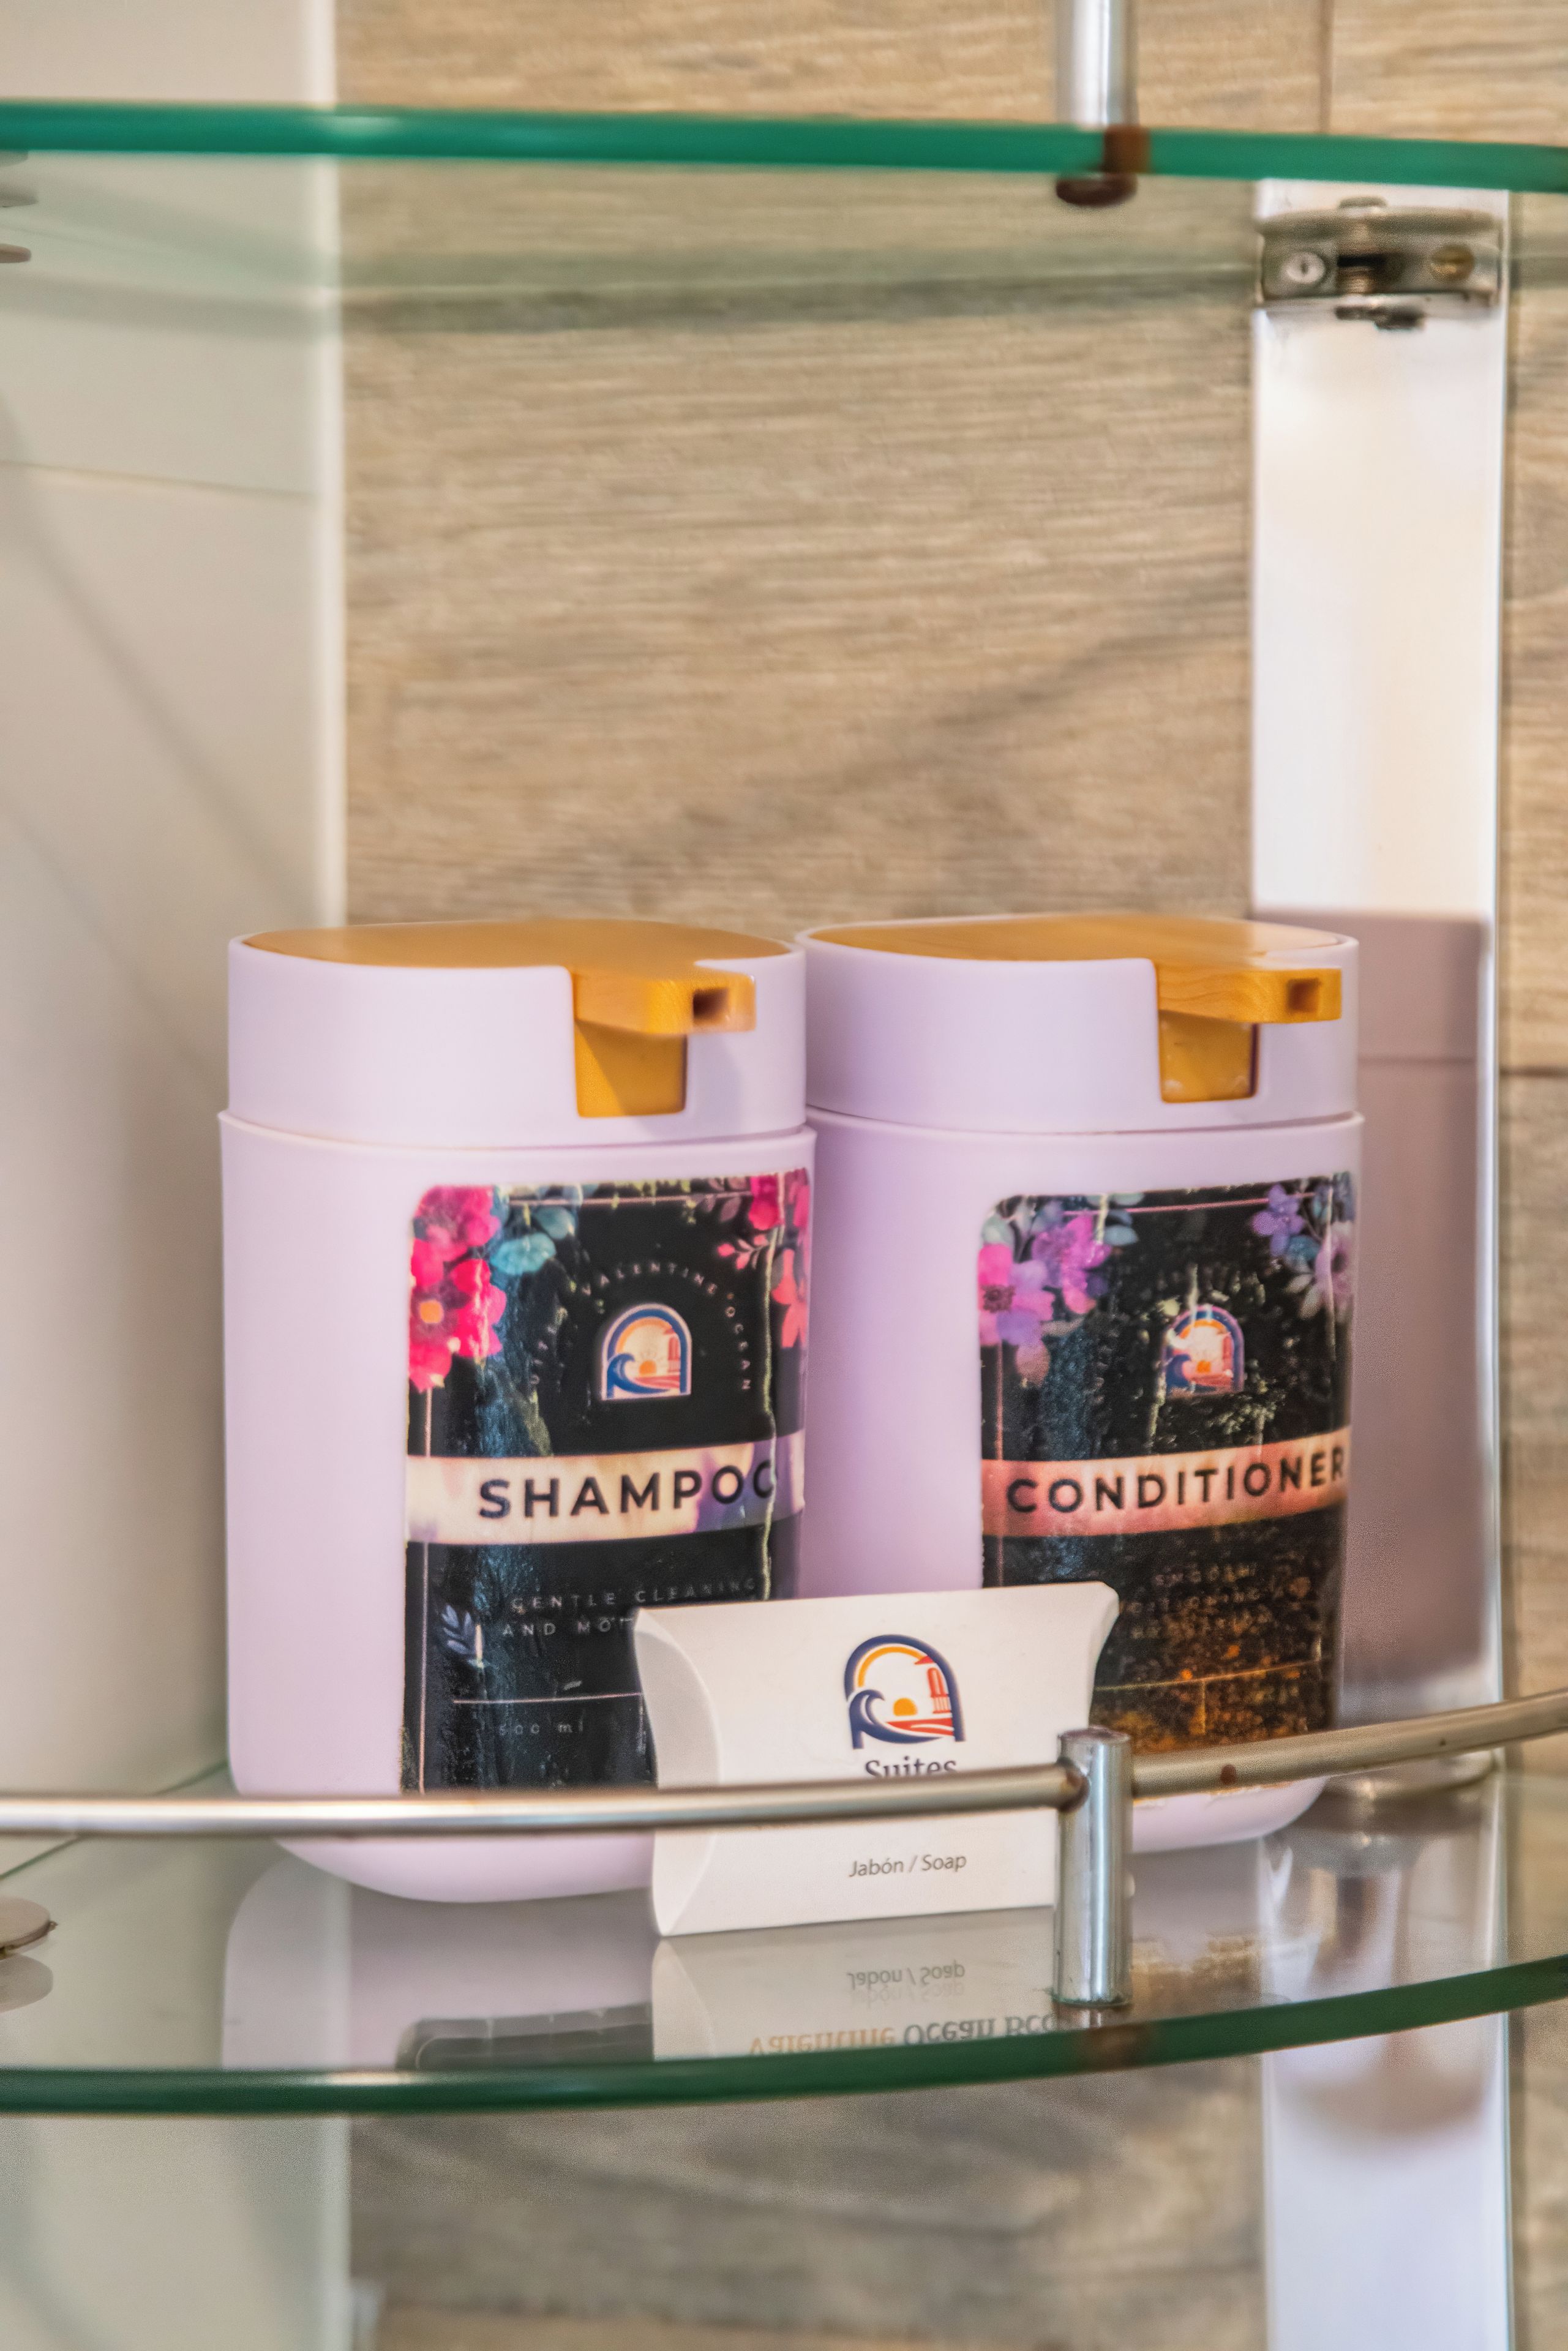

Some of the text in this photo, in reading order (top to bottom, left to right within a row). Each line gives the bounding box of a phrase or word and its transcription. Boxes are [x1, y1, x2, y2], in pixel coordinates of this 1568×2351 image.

[1007, 1445, 1344, 1513] CONDITIONER
[511, 1591, 616, 1611] GENTLE
[501, 1622, 557, 1637] AND
[865, 1755, 957, 1778] Suites
[849, 1854, 967, 1878] Jabón / Soap
